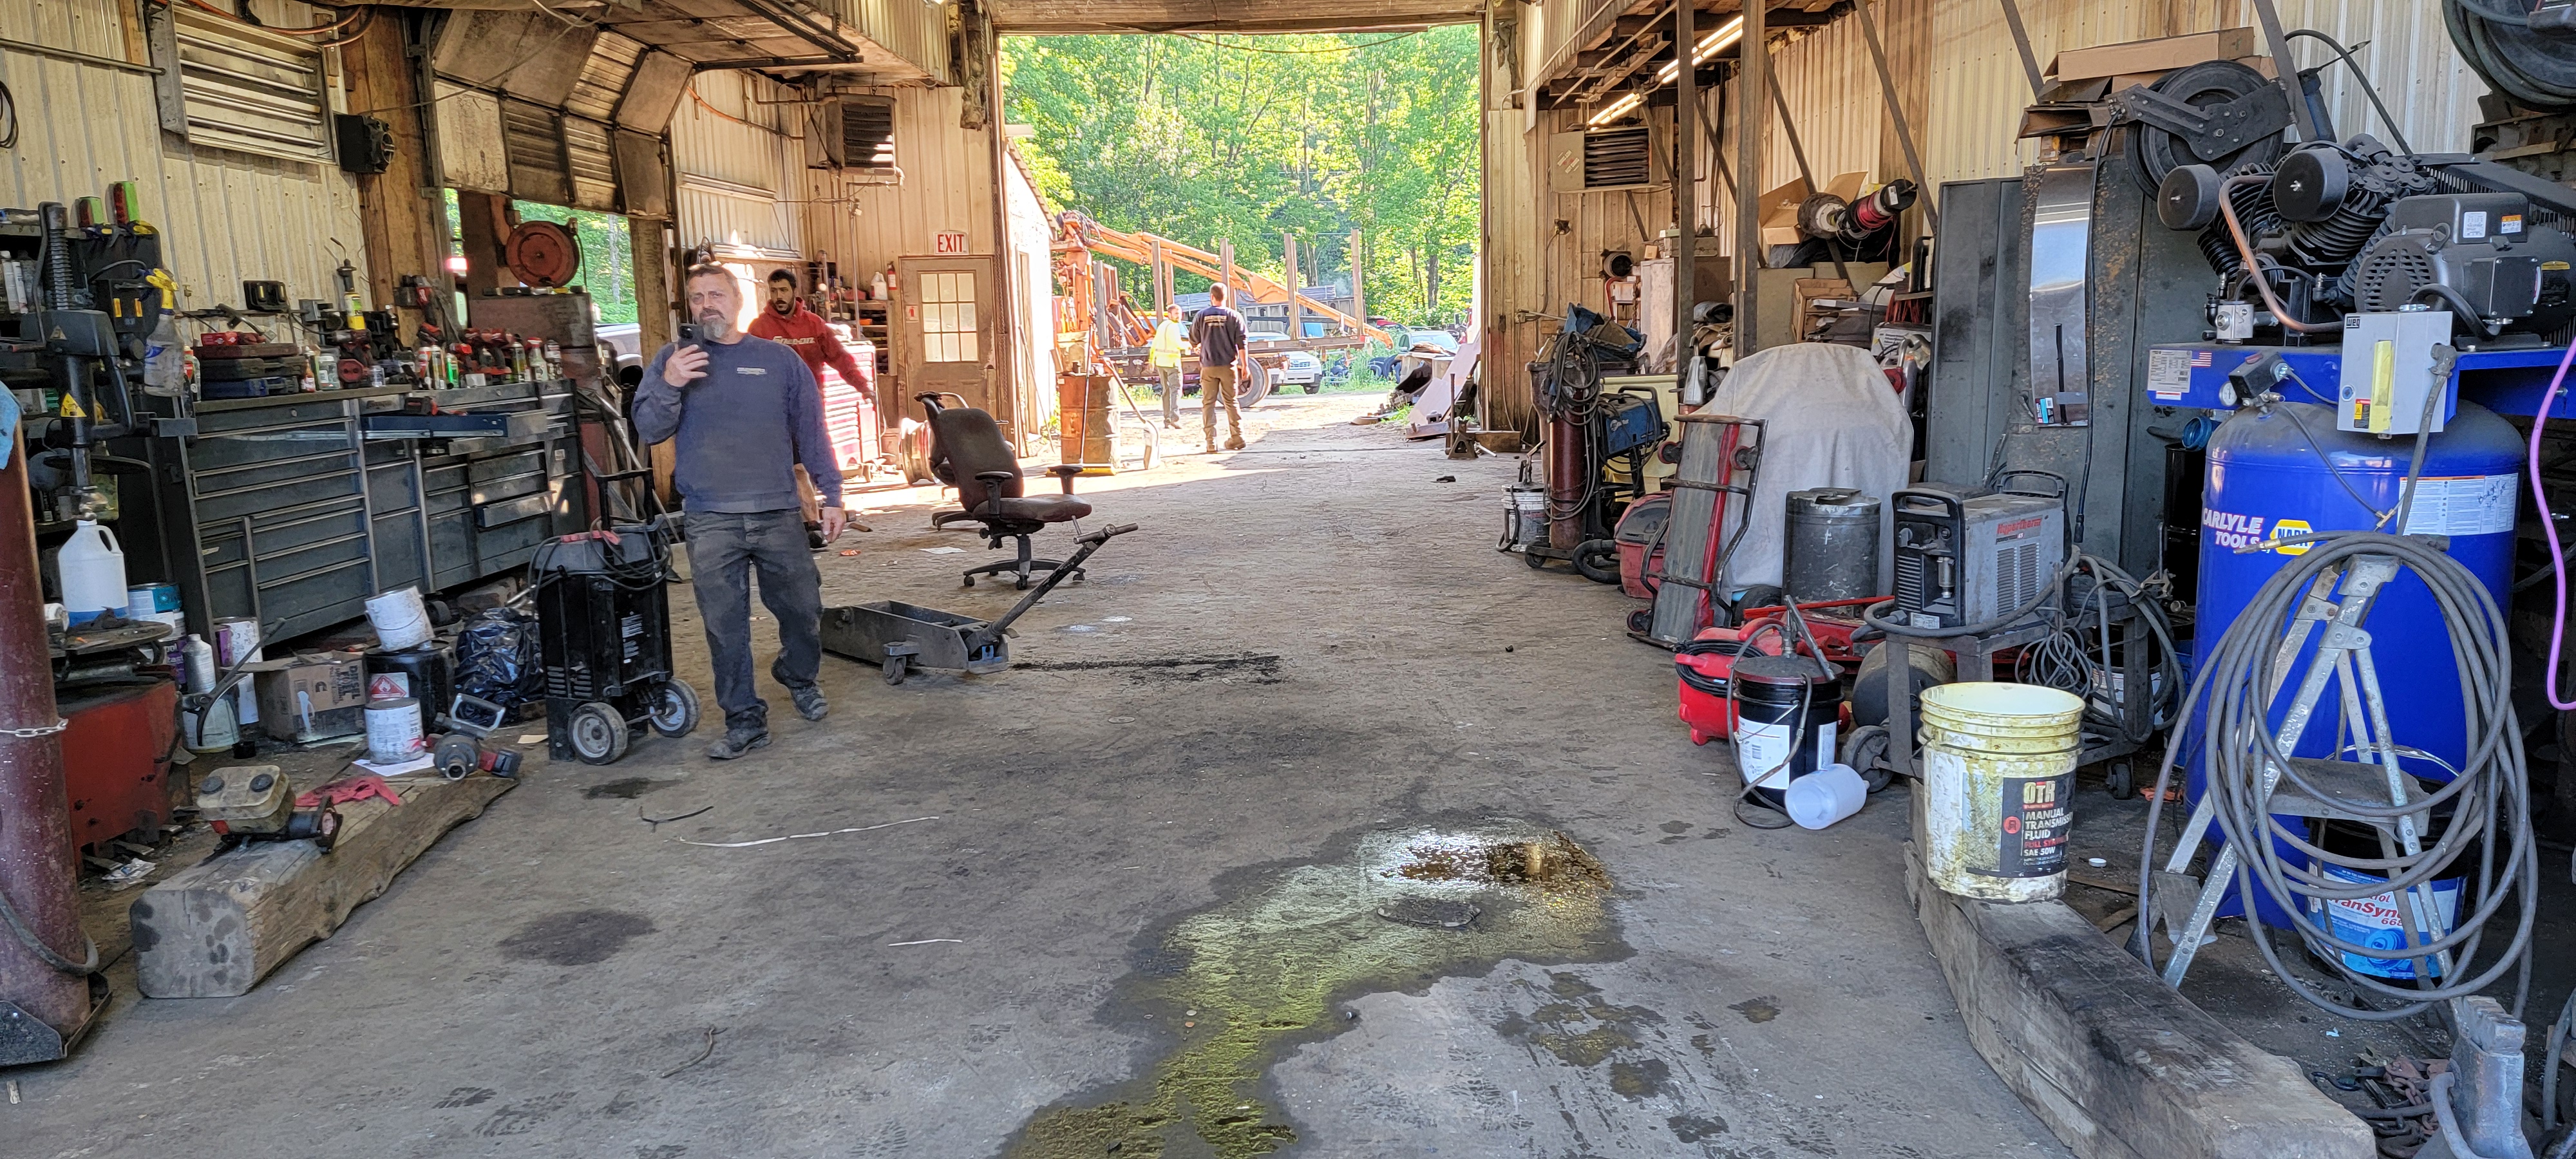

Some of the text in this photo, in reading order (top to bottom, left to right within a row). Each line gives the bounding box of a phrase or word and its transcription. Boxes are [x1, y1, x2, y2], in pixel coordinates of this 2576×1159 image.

[938, 234, 965, 252] EXIT
[1997, 518, 2041, 535] Hypertherm
[2202, 507, 2264, 534] CARLYLE
[2215, 531, 2260, 549] TOOLS
[349, 665, 361, 700] DIESEL
[2023, 780, 2056, 804] OTR
[2026, 807, 2064, 821] MANUAL
[2024, 829, 2051, 840] FLUID
[2040, 846, 2056, 855] 50W
